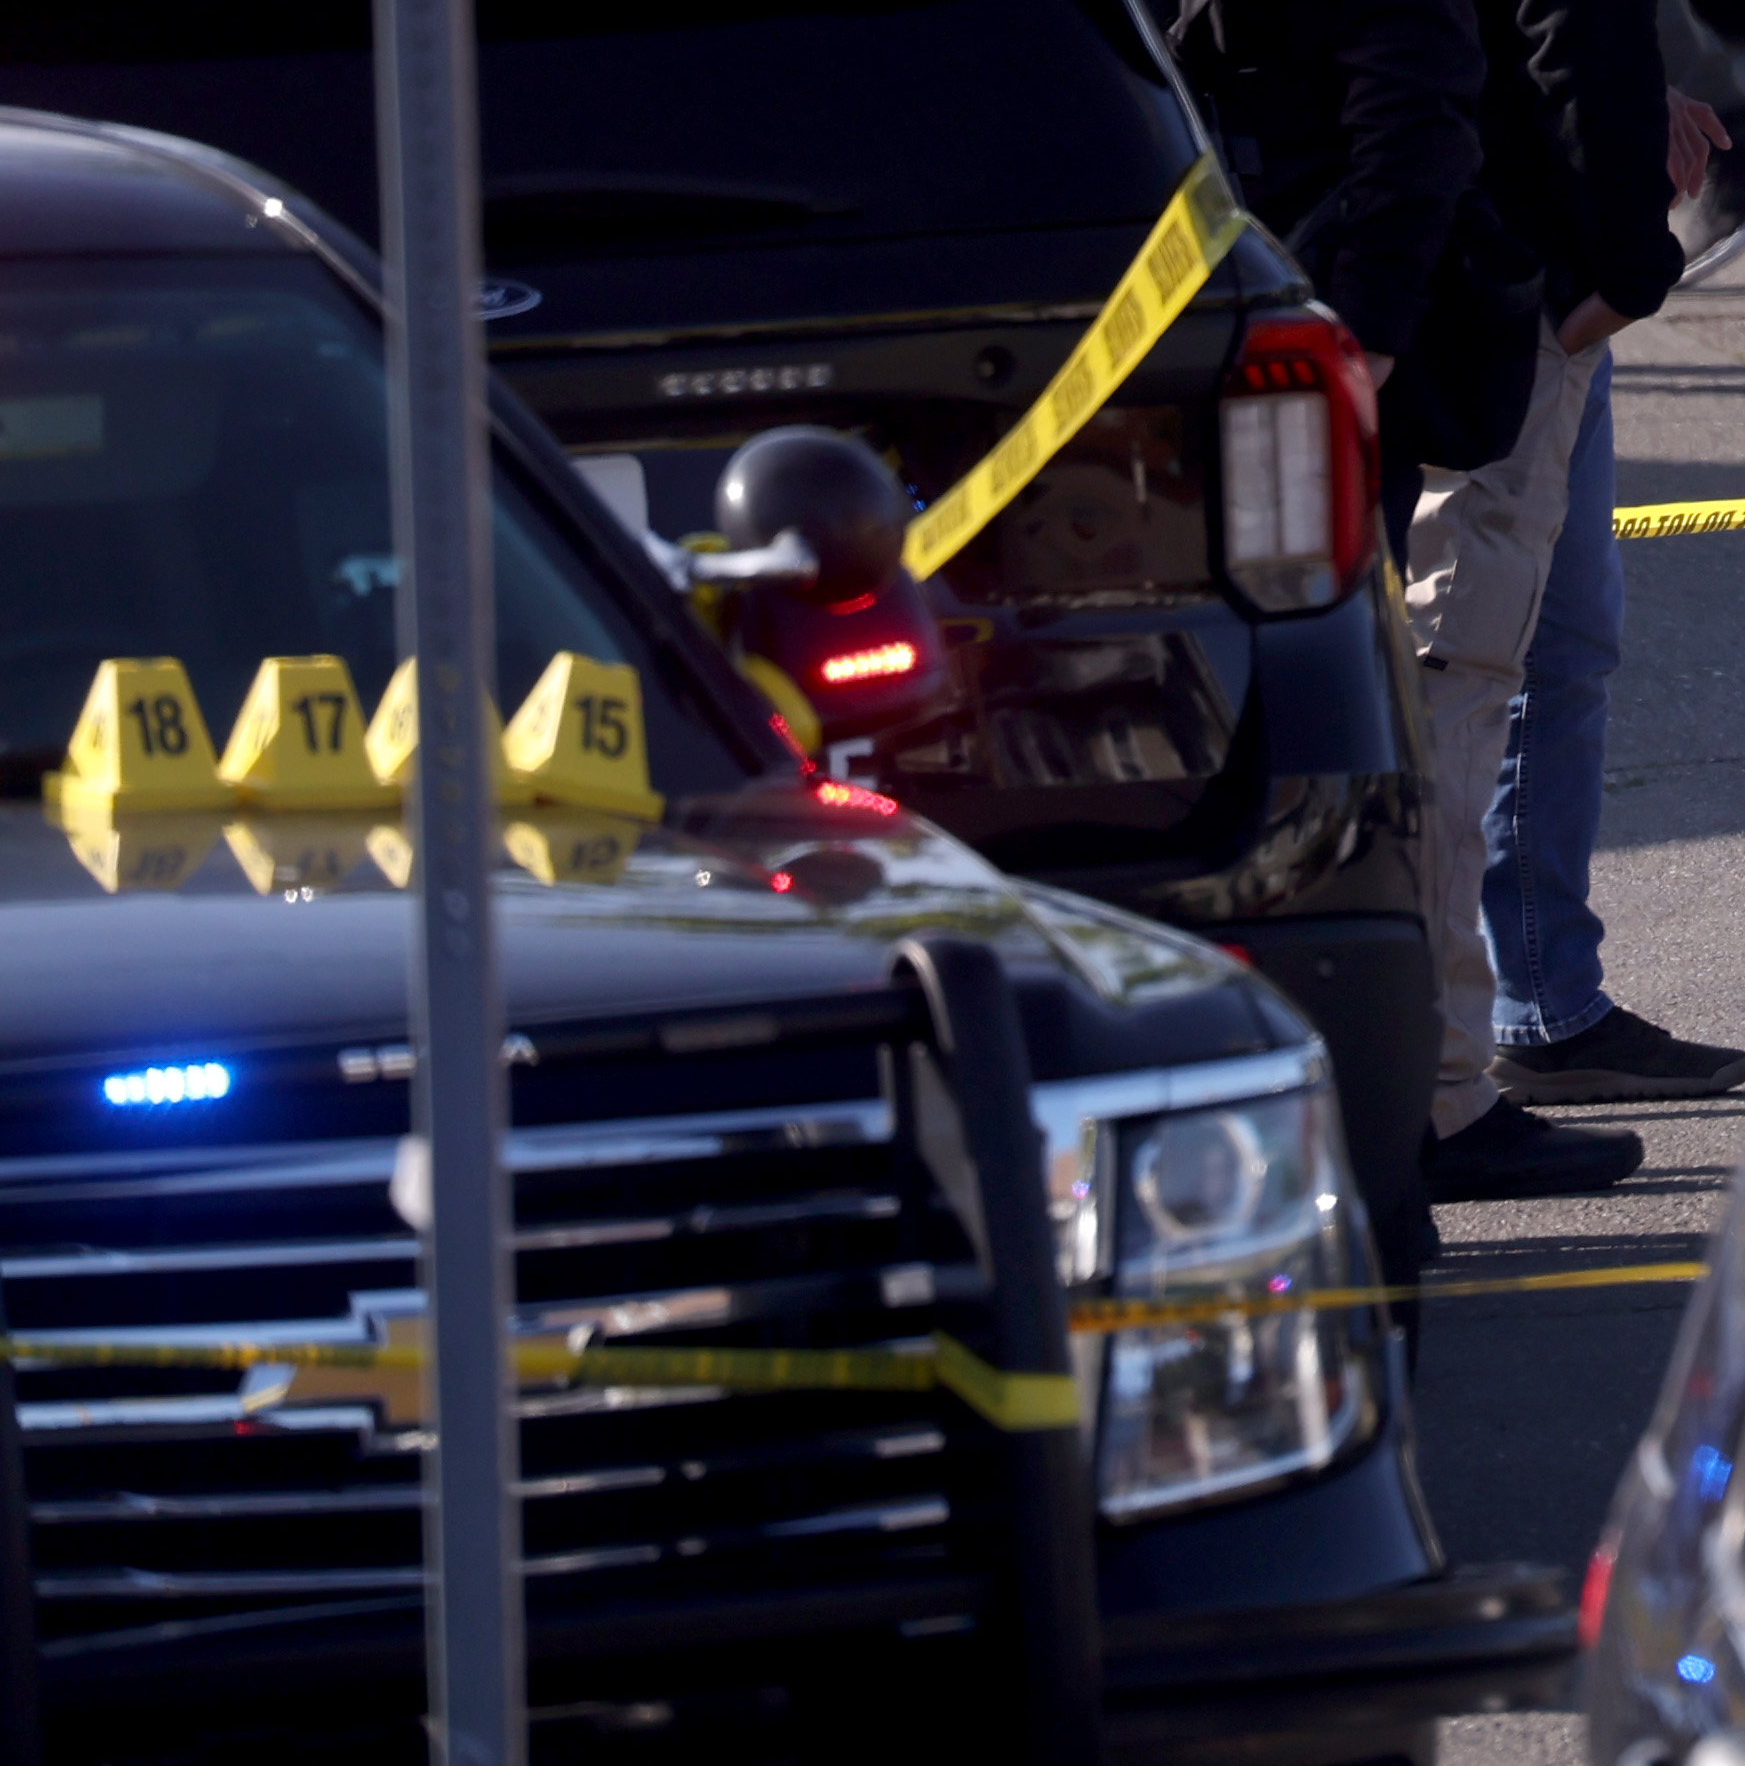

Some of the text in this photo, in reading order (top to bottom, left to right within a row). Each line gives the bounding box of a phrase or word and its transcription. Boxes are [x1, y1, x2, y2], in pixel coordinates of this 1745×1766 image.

[128, 692, 189, 756] 18
[294, 693, 348, 752] 17
[574, 692, 629, 759] 15
